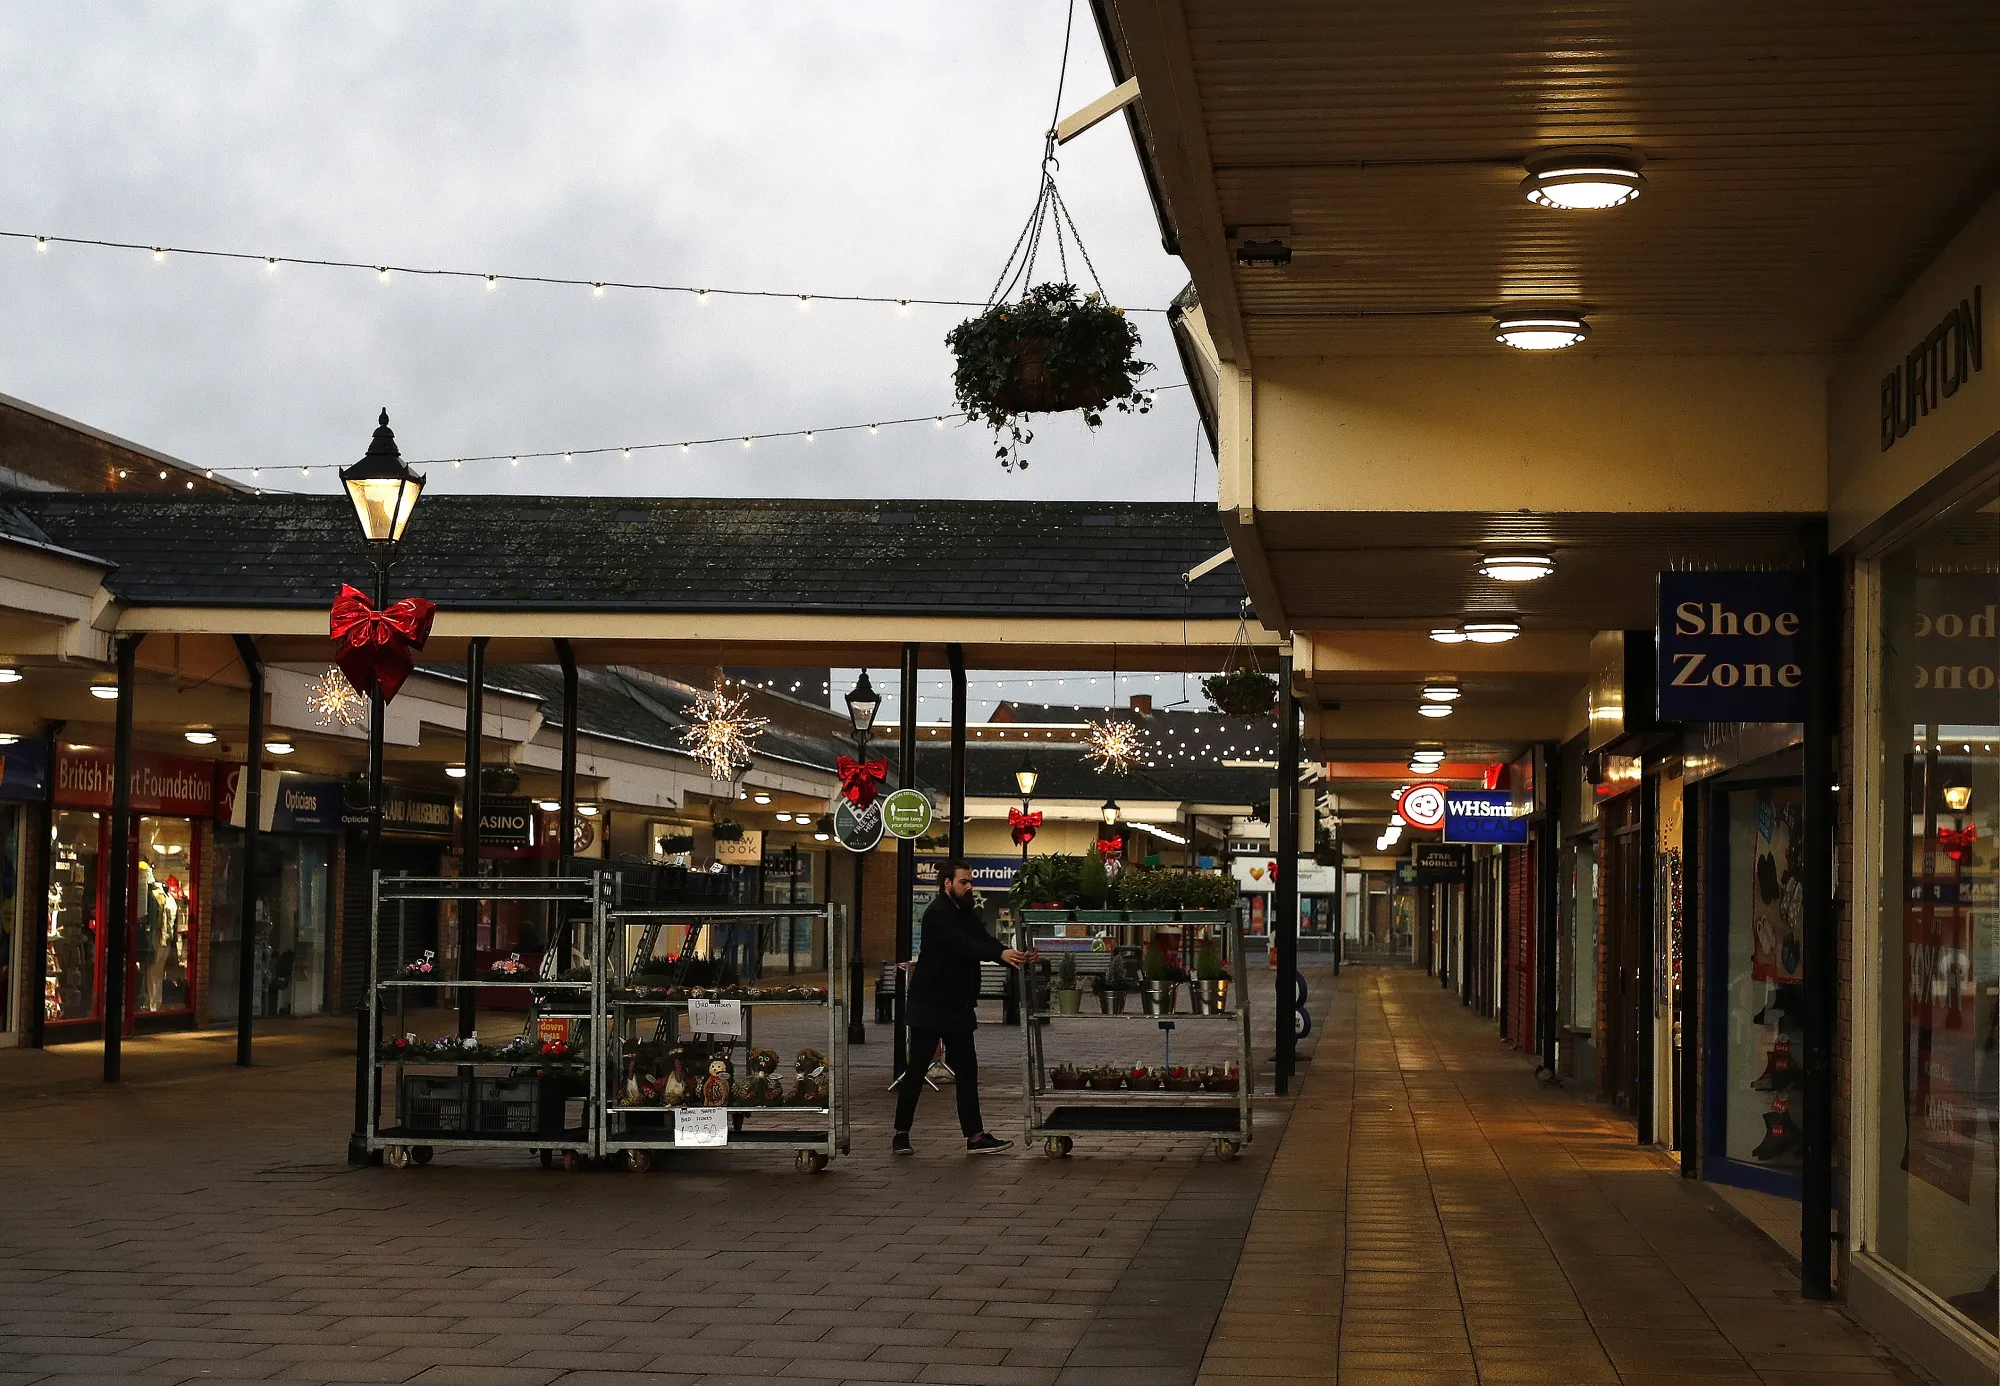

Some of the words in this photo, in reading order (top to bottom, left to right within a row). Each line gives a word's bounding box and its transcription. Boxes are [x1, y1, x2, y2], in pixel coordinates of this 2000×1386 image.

[1881, 284, 1982, 453] BURTON
[1675, 601, 1801, 636] Shoe
[1670, 653, 1804, 688] Zone
[59, 758, 101, 792] British
[105, 763, 140, 795] Hrt
[143, 767, 211, 801] Foundation
[285, 788, 317, 813] Opticians
[1448, 800, 1514, 817] WHSmi
[341, 815, 369, 824] Opticia
[385, 799, 405, 821] LAND
[405, 799, 450, 826] AMUSEMENTS
[853, 820, 868, 835] FREE
[865, 804, 879, 821] WIFI
[480, 815, 525, 829] ASINO
[863, 815, 879, 833] HERE
[1456, 819, 1520, 833] LOCAL
[718, 845, 757, 854] LOOK
[970, 866, 1018, 879] ortrait
[540, 1021, 564, 1031] down
[1775, 1043, 1789, 1052] SALE
[1773, 1102, 1786, 1111] SALE
